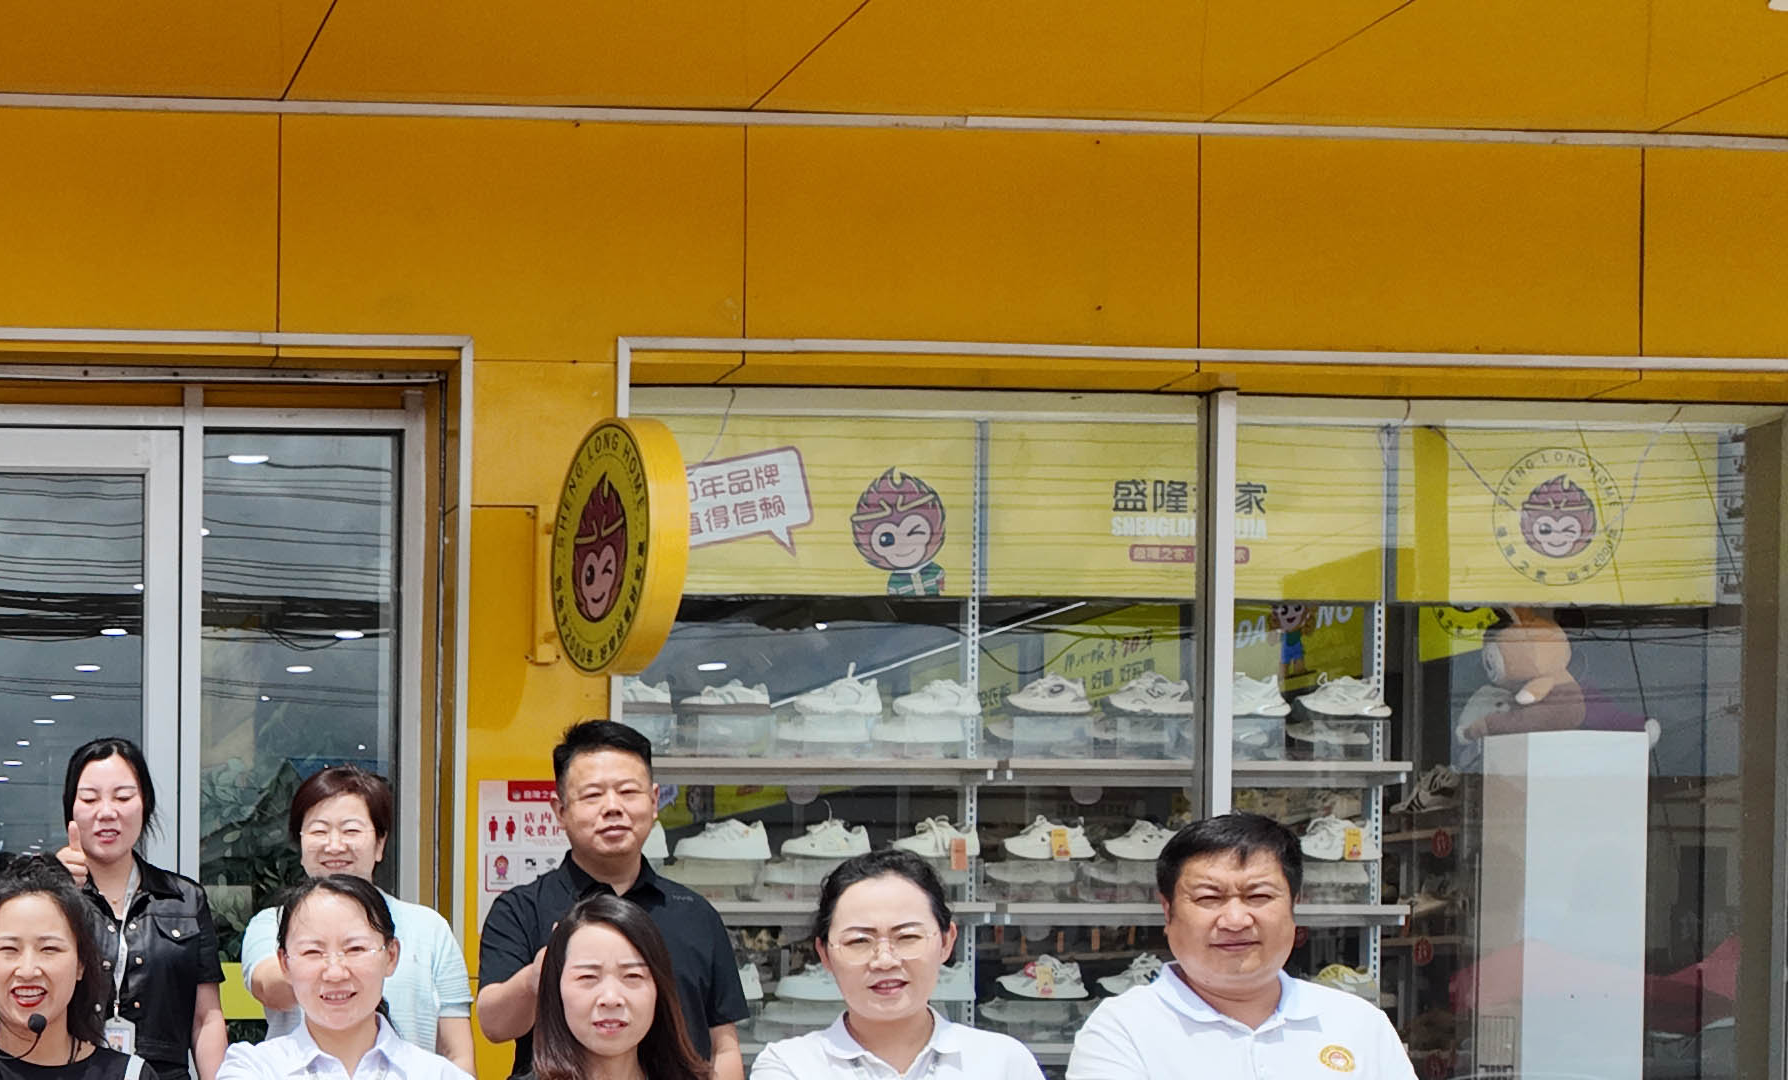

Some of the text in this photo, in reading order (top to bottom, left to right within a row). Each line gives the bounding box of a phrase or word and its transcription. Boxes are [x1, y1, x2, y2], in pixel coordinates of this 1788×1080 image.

[587, 433, 619, 460] LONG
[623, 442, 645, 512] HOME
[1541, 452, 1587, 468] LONG
[1113, 479, 1267, 515] 盛隆家
